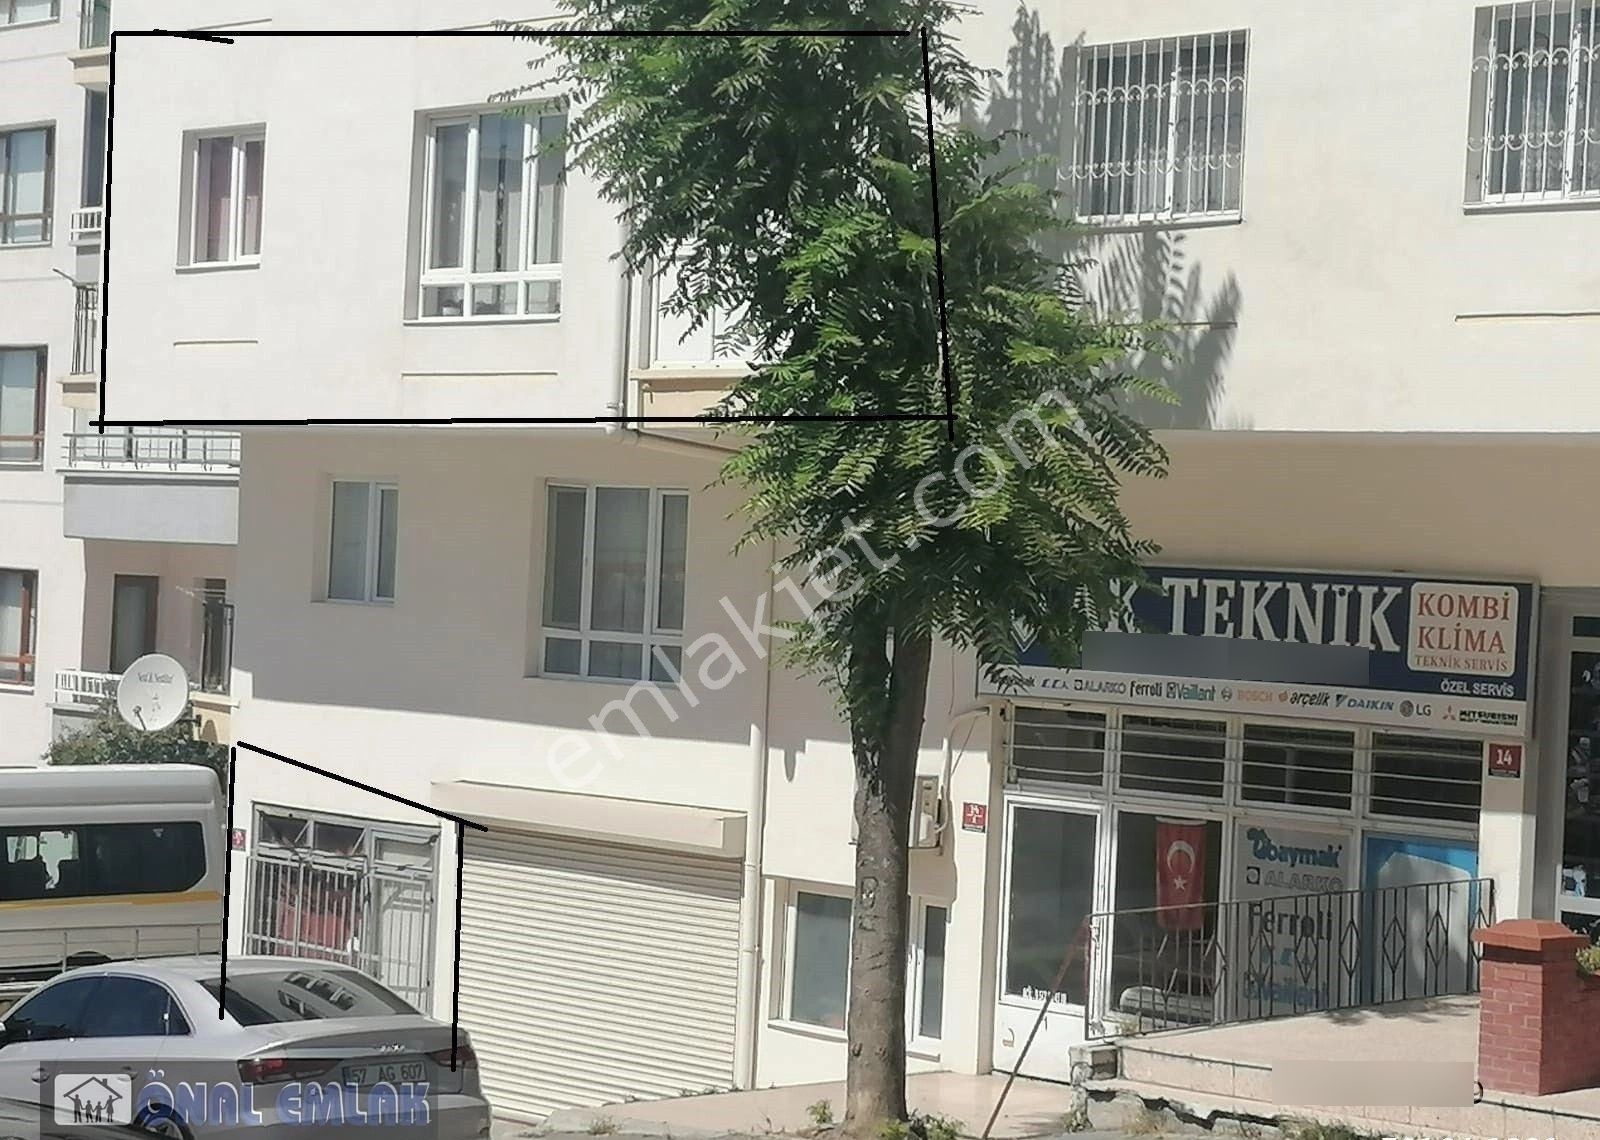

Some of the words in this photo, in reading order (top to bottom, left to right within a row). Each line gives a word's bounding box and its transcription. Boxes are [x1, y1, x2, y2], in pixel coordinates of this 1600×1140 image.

[1161, 577, 1402, 652] TEKNİK
[1417, 592, 1510, 621] KOMBİ
[1417, 623, 1506, 654] KLİMA
[1415, 654, 1461, 669] TEKNİK
[1464, 657, 1508, 672] SERVİS
[1440, 678, 1471, 694] ÖZEL
[1473, 682, 1515, 698] SERVİS
[1347, 697, 1395, 712] DAIKIN
[1415, 703, 1432, 717] LG
[1496, 749, 1513, 766] 14
[379, 1066, 396, 1081] AG
[401, 1063, 423, 1080] 607
